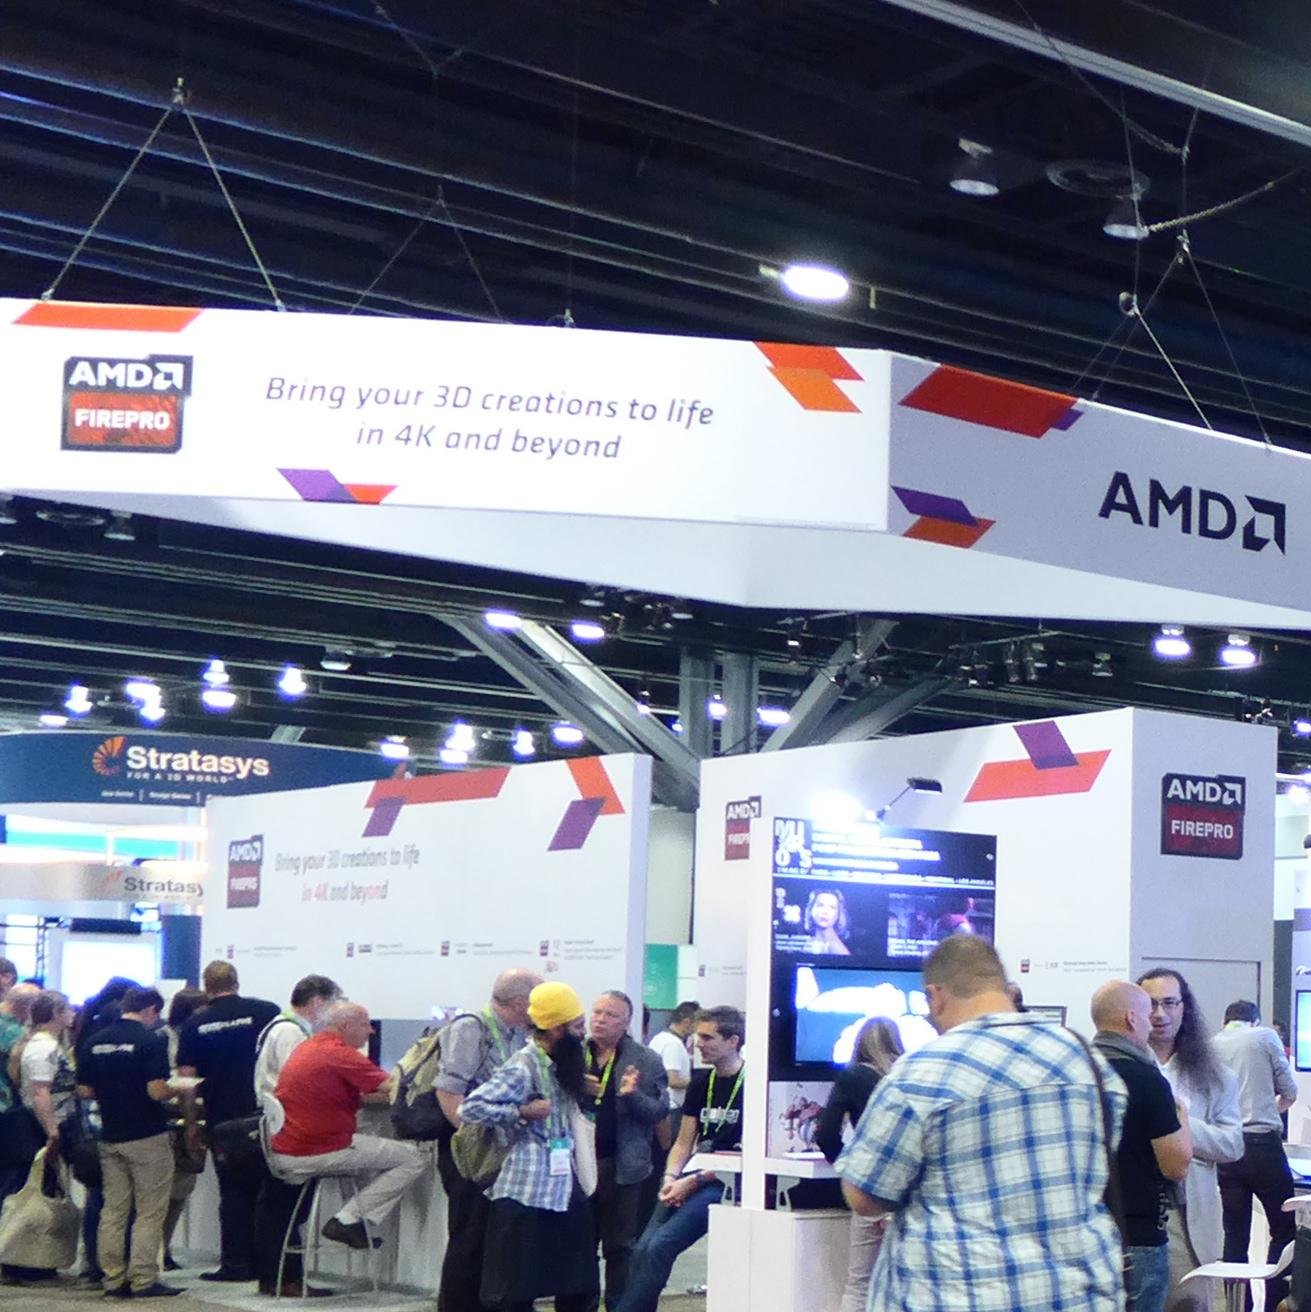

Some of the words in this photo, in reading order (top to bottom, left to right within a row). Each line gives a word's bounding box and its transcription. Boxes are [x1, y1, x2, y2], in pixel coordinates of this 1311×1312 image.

[68, 360, 154, 389] AMD
[266, 377, 347, 410] Bring
[356, 386, 425, 410] your
[433, 384, 473, 409] 3D
[481, 391, 619, 418] creations
[628, 398, 658, 421] to
[667, 398, 715, 430] life
[74, 408, 171, 431] FIREPRO
[356, 421, 385, 446] in
[394, 424, 437, 448] 4K
[445, 428, 503, 451] and
[511, 428, 622, 461] beyond
[1098, 470, 1238, 540] AMD
[126, 745, 270, 780] Stratasys
[1166, 778, 1222, 802] AMD
[727, 802, 751, 820] AMD
[1171, 819, 1234, 840] FIREPRO
